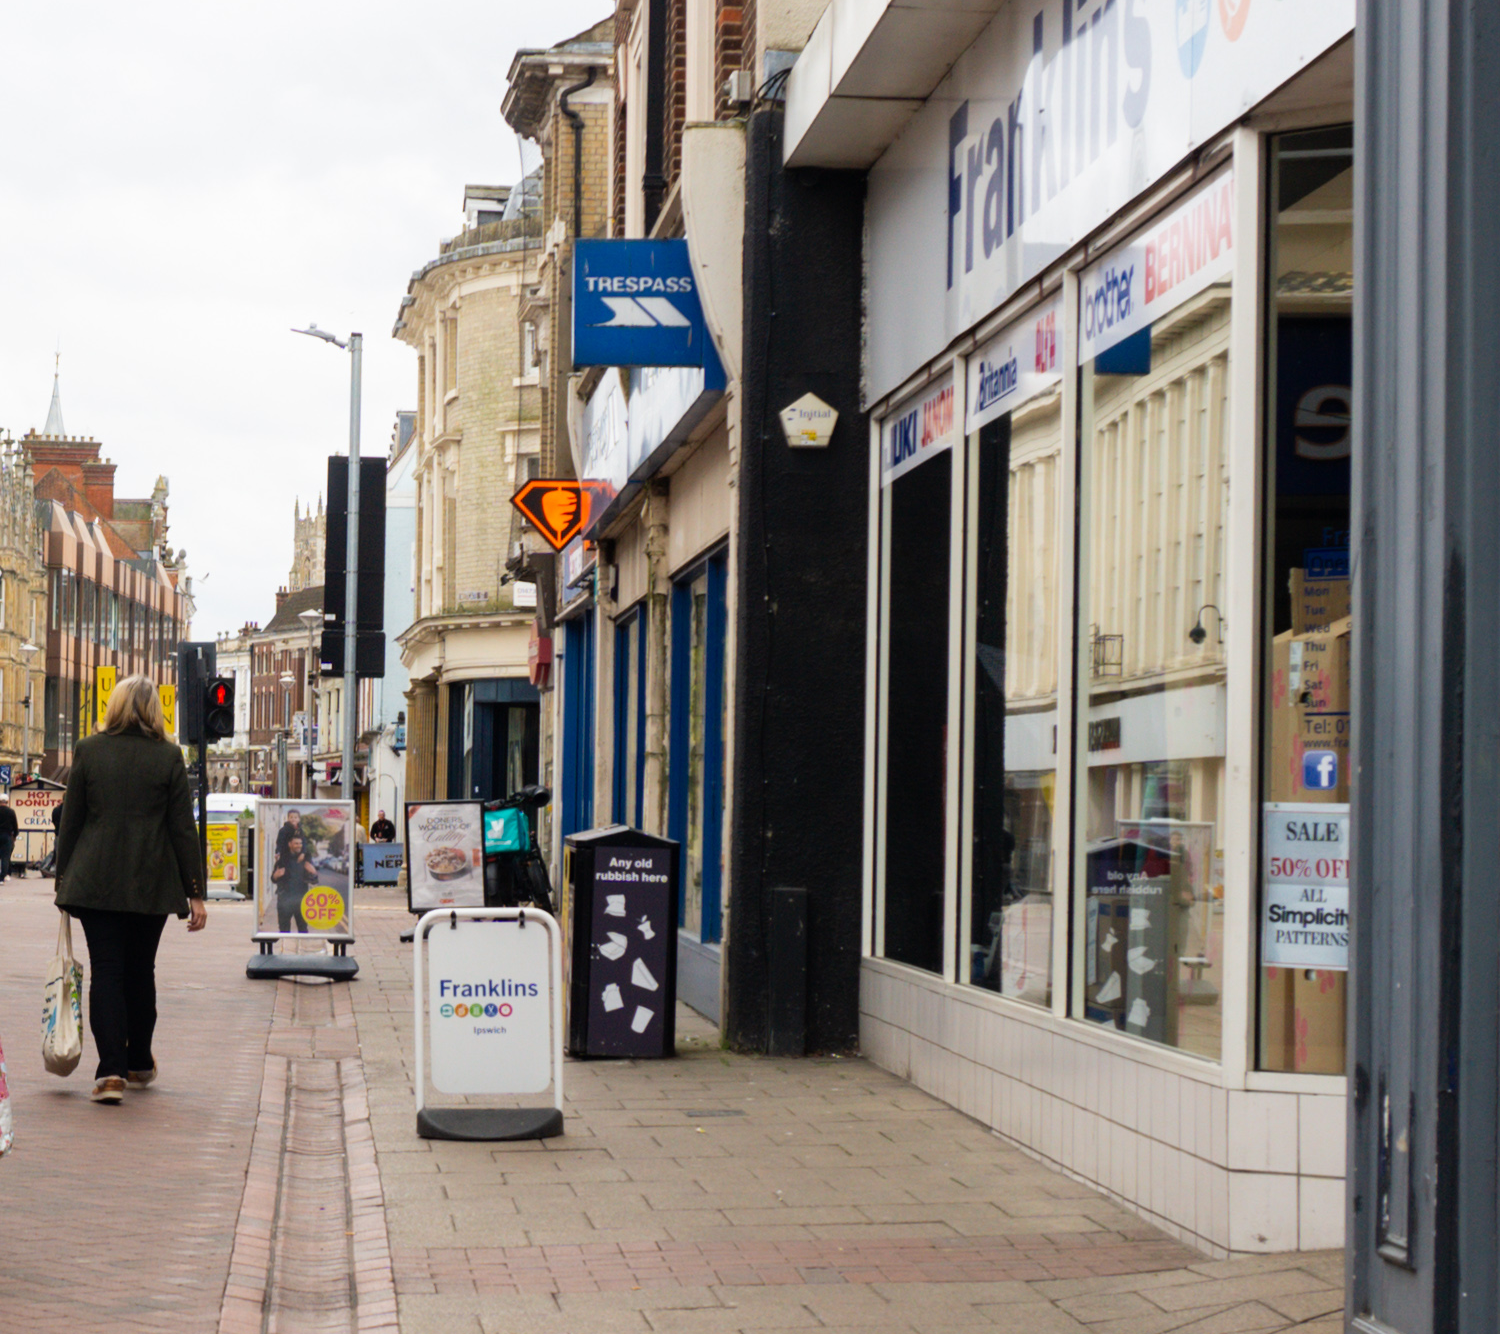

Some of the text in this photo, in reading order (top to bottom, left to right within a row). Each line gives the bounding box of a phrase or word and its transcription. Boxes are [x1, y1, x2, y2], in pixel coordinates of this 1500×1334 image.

[584, 276, 692, 293] TRESPASS
[1084, 264, 1134, 341] brother
[799, 409, 831, 421] Initial
[1304, 586, 1330, 597] Mon
[1304, 604, 1326, 615] Tue
[1304, 622, 1331, 634] Wed
[1304, 640, 1326, 652] Thu
[1304, 659, 1319, 671] Fri
[1304, 679, 1323, 690] Sat
[1304, 696, 1326, 708] Sun
[1304, 719, 1331, 734] Tel:
[27, 791, 52, 799] HOT
[33, 809, 45, 817] ICE
[1286, 821, 1338, 841] SALE
[375, 860, 403, 869] NER
[609, 857, 653, 869] Any old
[1270, 857, 1311, 877] 50%
[596, 871, 668, 883] rubbish here
[305, 893, 340, 908] 60%
[1299, 889, 1327, 902] ALL
[305, 908, 337, 921] OFF
[1276, 930, 1349, 947] PATTERNS
[439, 979, 539, 997] Franklins
[473, 1025, 507, 1035] Ipswich
